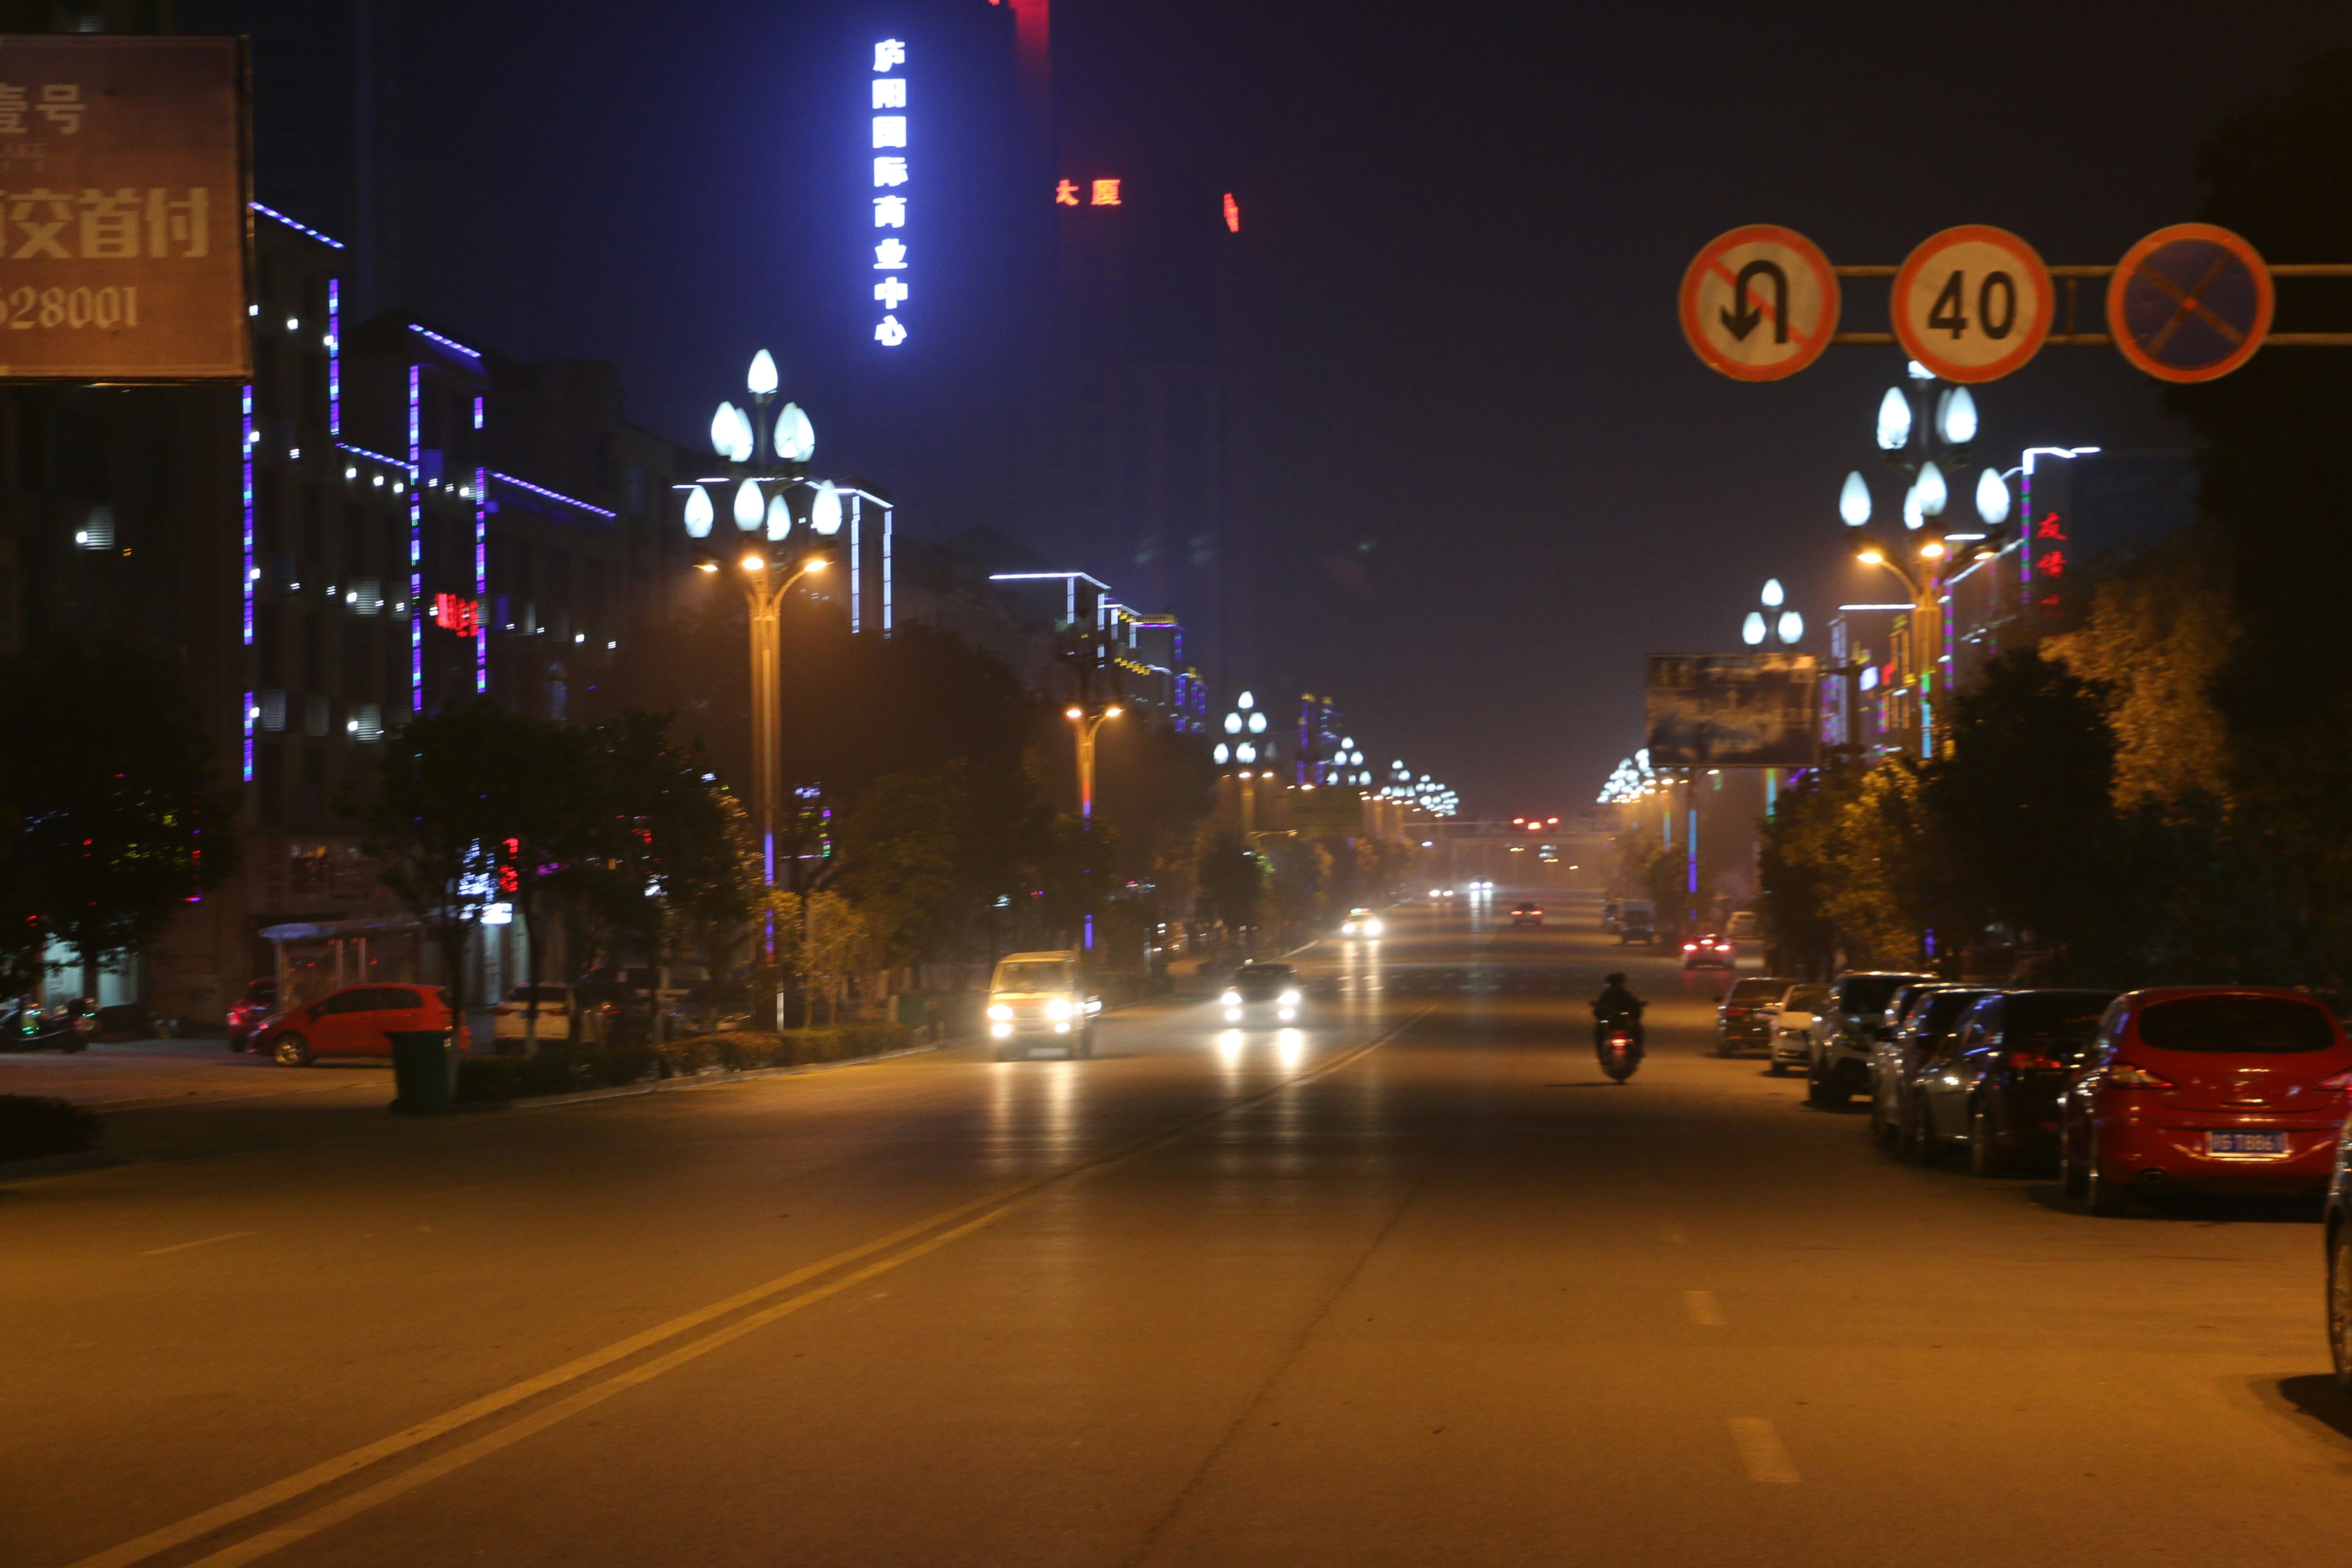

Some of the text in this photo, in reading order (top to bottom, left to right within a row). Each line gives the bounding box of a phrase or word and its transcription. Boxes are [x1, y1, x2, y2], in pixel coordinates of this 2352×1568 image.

[0, 187, 211, 259] 交首付
[1056, 180, 1121, 205] 大厦
[1927, 269, 2017, 340] 40
